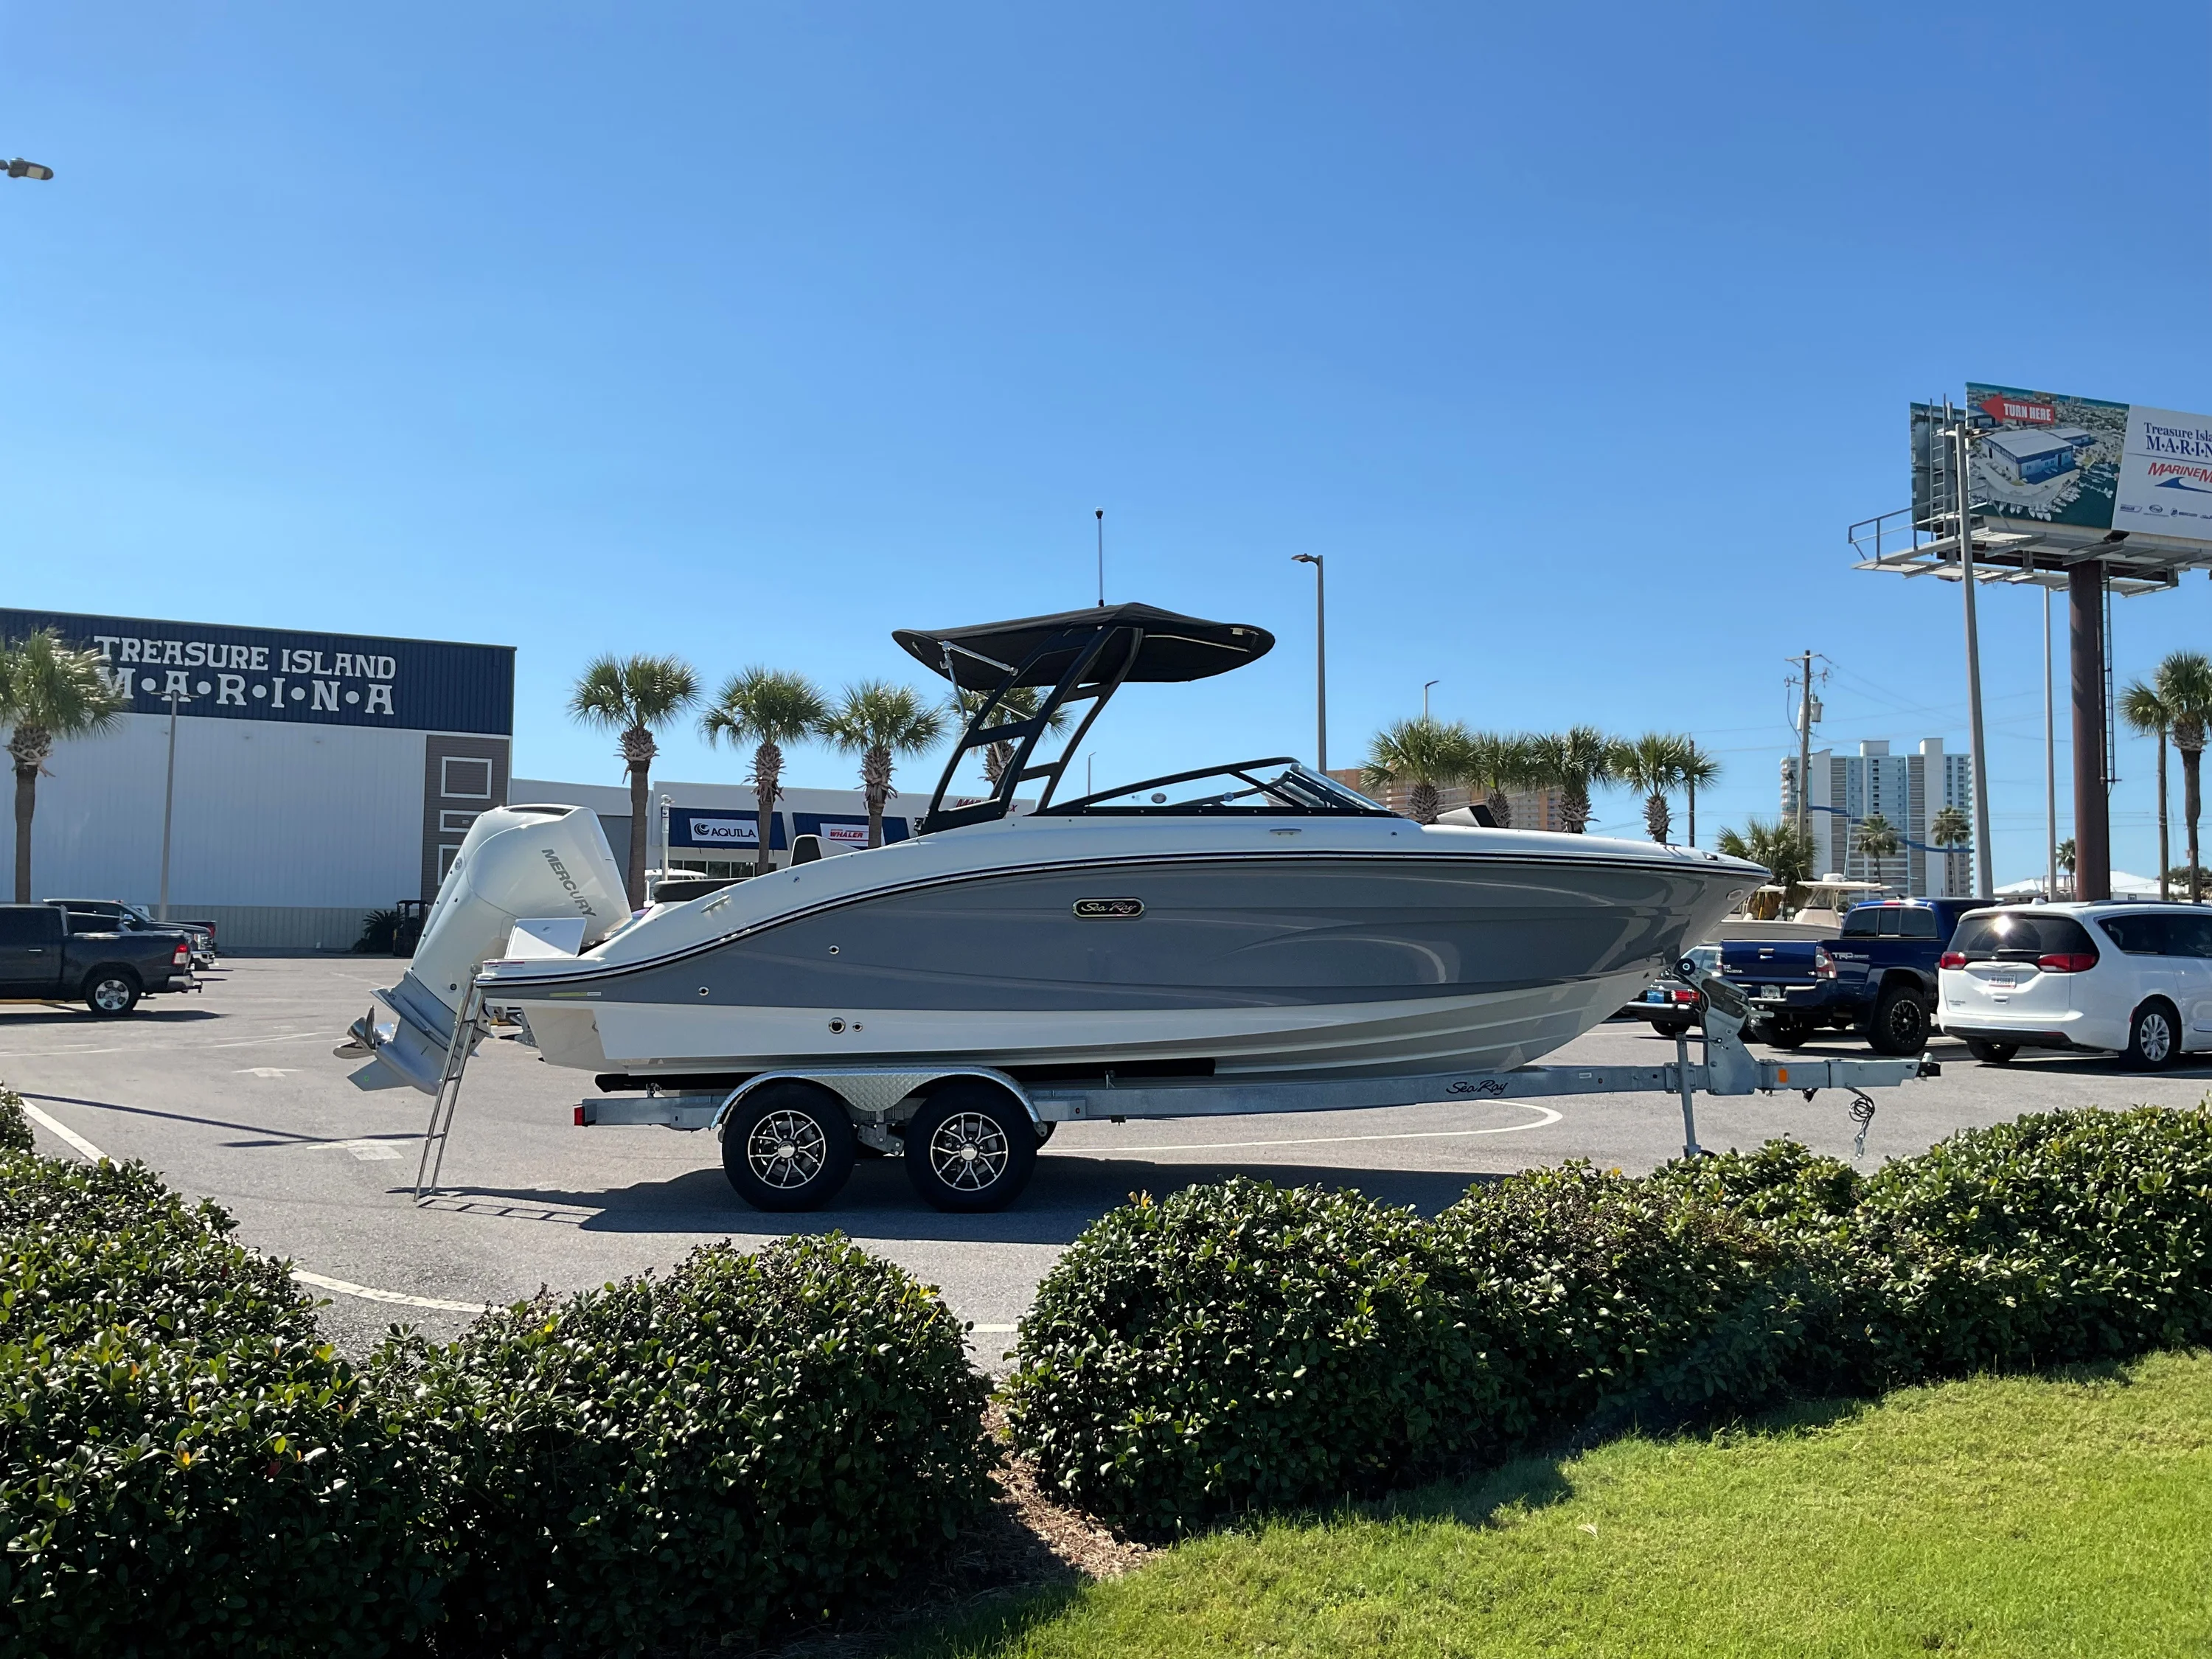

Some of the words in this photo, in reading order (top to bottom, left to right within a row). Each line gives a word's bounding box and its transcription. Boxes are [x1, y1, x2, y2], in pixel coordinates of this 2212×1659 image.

[2003, 403, 2028, 418] TURN
[2029, 406, 2051, 421] HERE
[2143, 422, 2193, 439] Treasure
[94, 636, 269, 671] TREASURE
[281, 648, 397, 680] ISLAND
[711, 827, 757, 838] AQUILA
[541, 849, 597, 917] MERCURY
[1081, 902, 1107, 911] Sea
[1109, 901, 1137, 913] Ray
[1446, 1081, 1478, 1094] Sea
[1477, 1079, 1509, 1096] Ray
